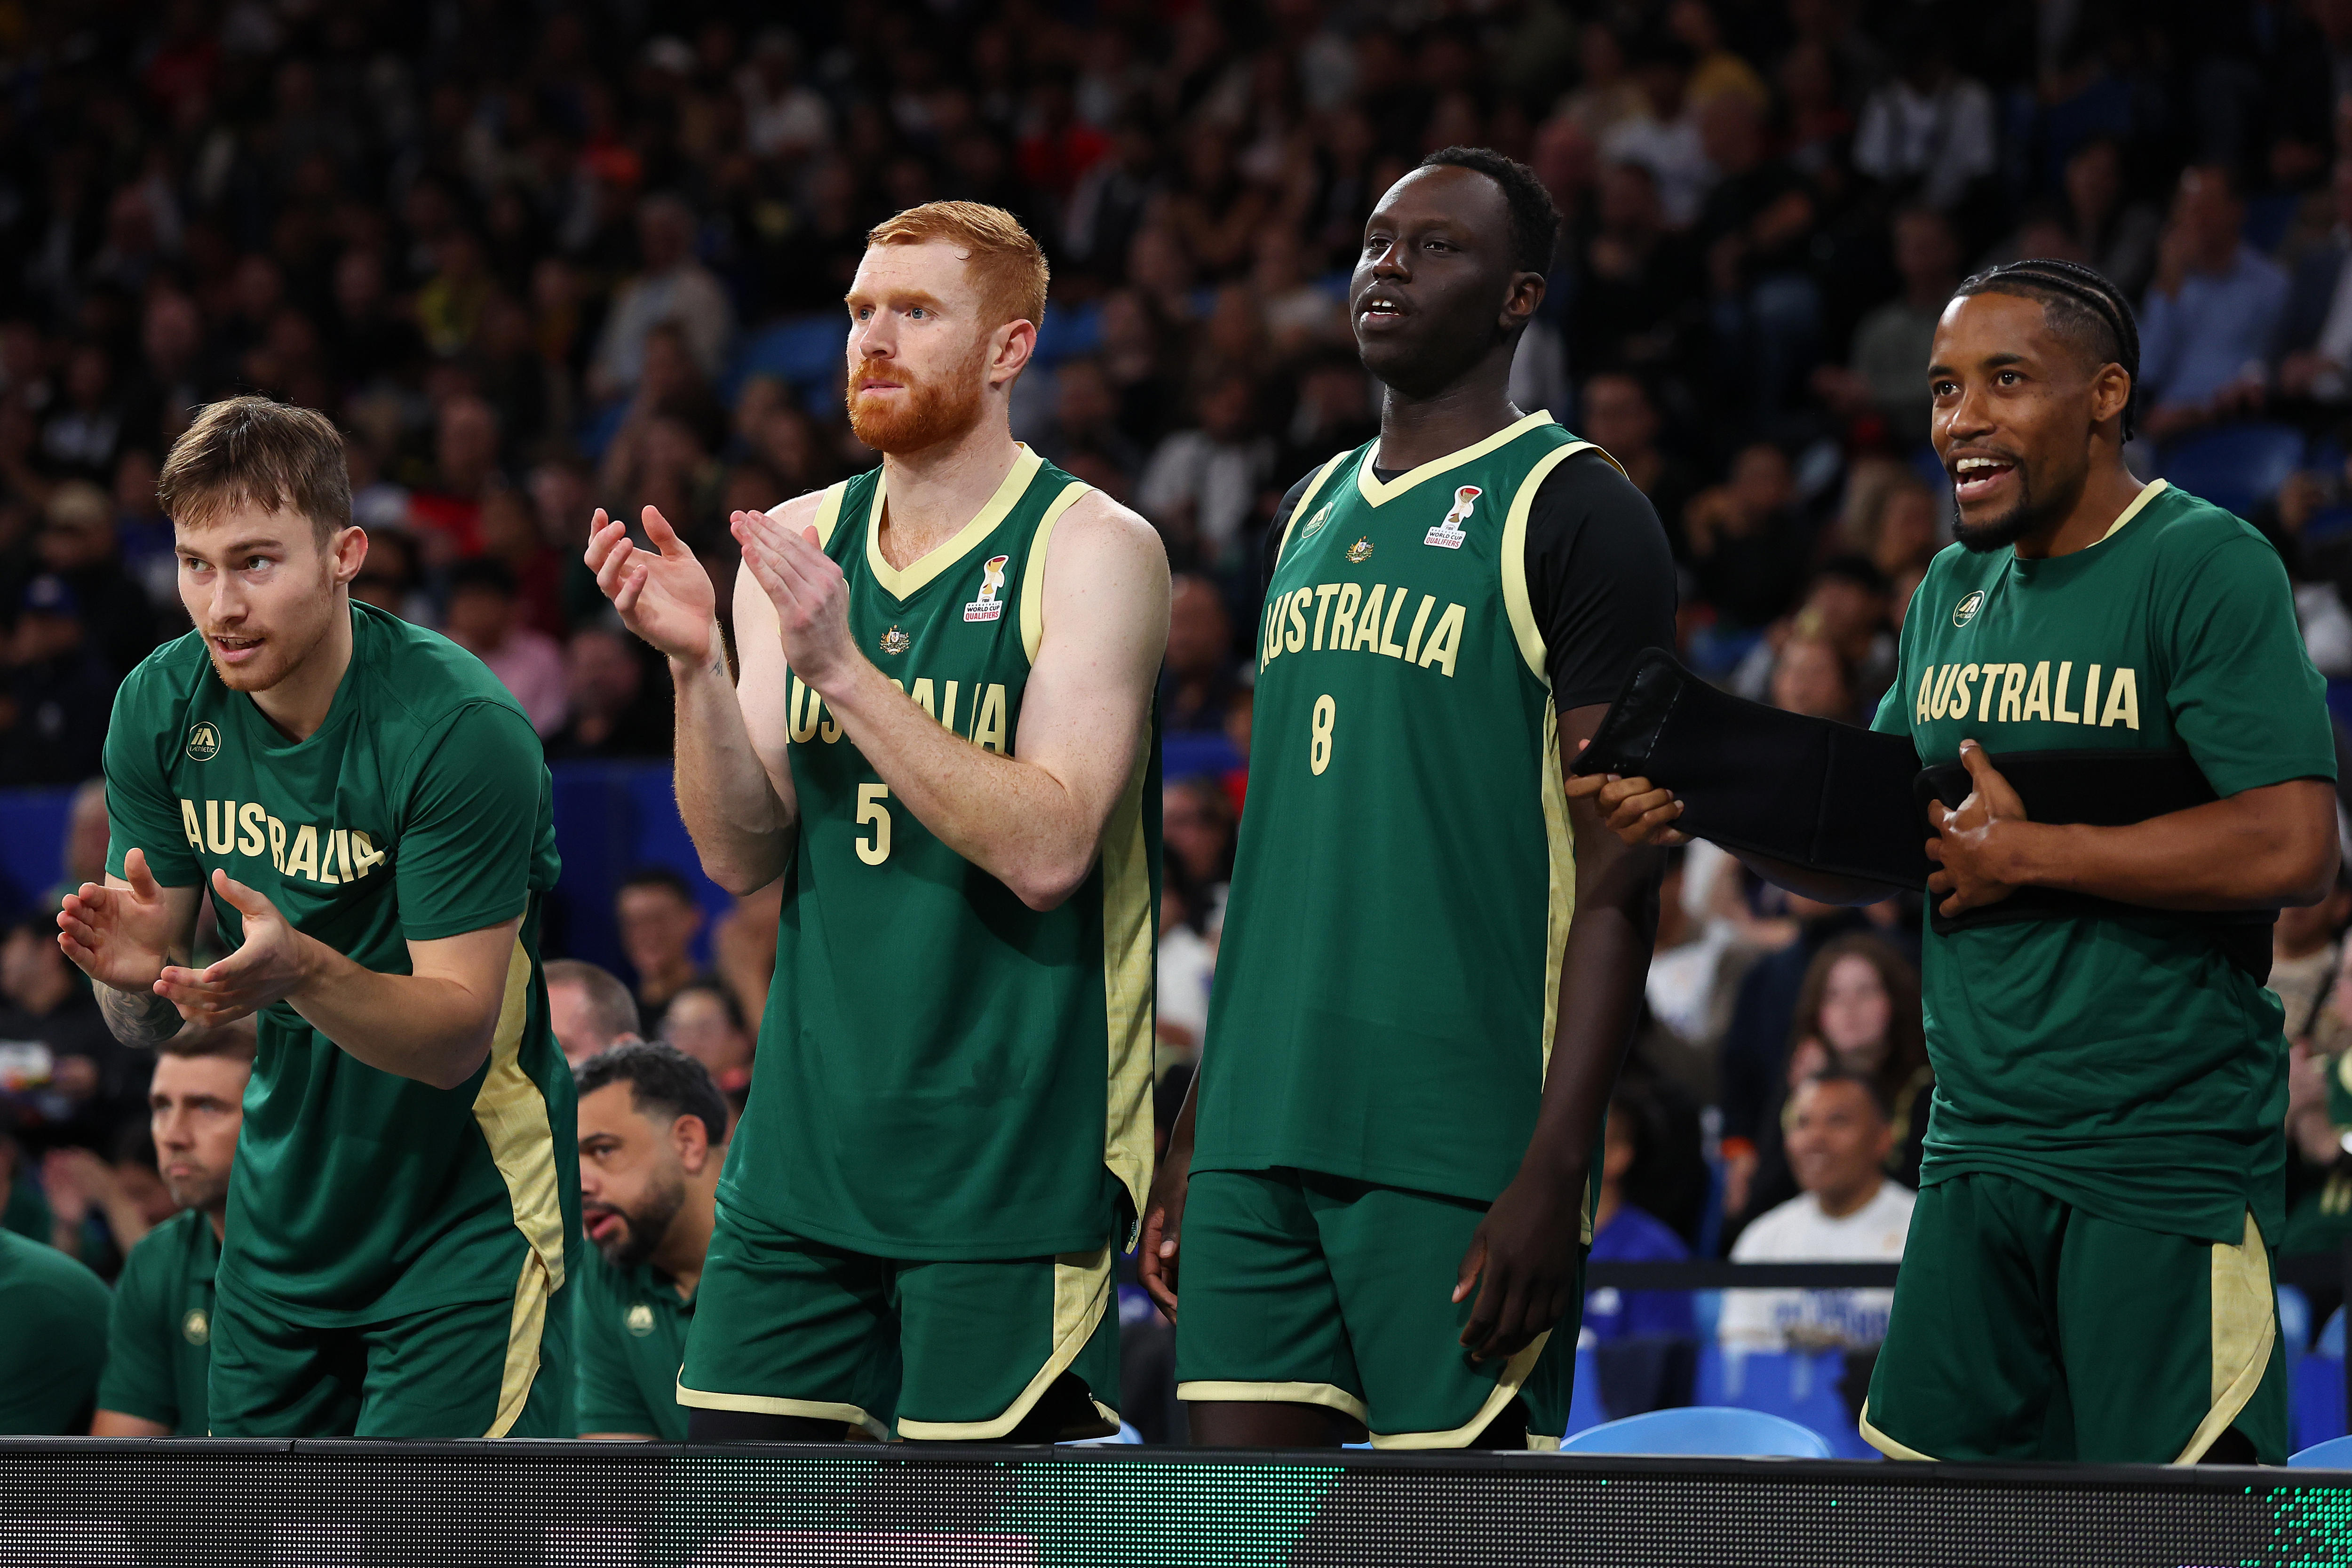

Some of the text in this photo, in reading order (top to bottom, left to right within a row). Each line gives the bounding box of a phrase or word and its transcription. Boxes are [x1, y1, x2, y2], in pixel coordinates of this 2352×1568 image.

[1426, 537, 1460, 547] QUALIFIERS
[966, 611, 998, 620] QUALIFIERS
[1260, 582, 1466, 678] AUSTRALIA
[1917, 661, 2139, 730] AUSTRALIA
[1311, 694, 1336, 776] 8
[855, 782, 891, 866] 5
